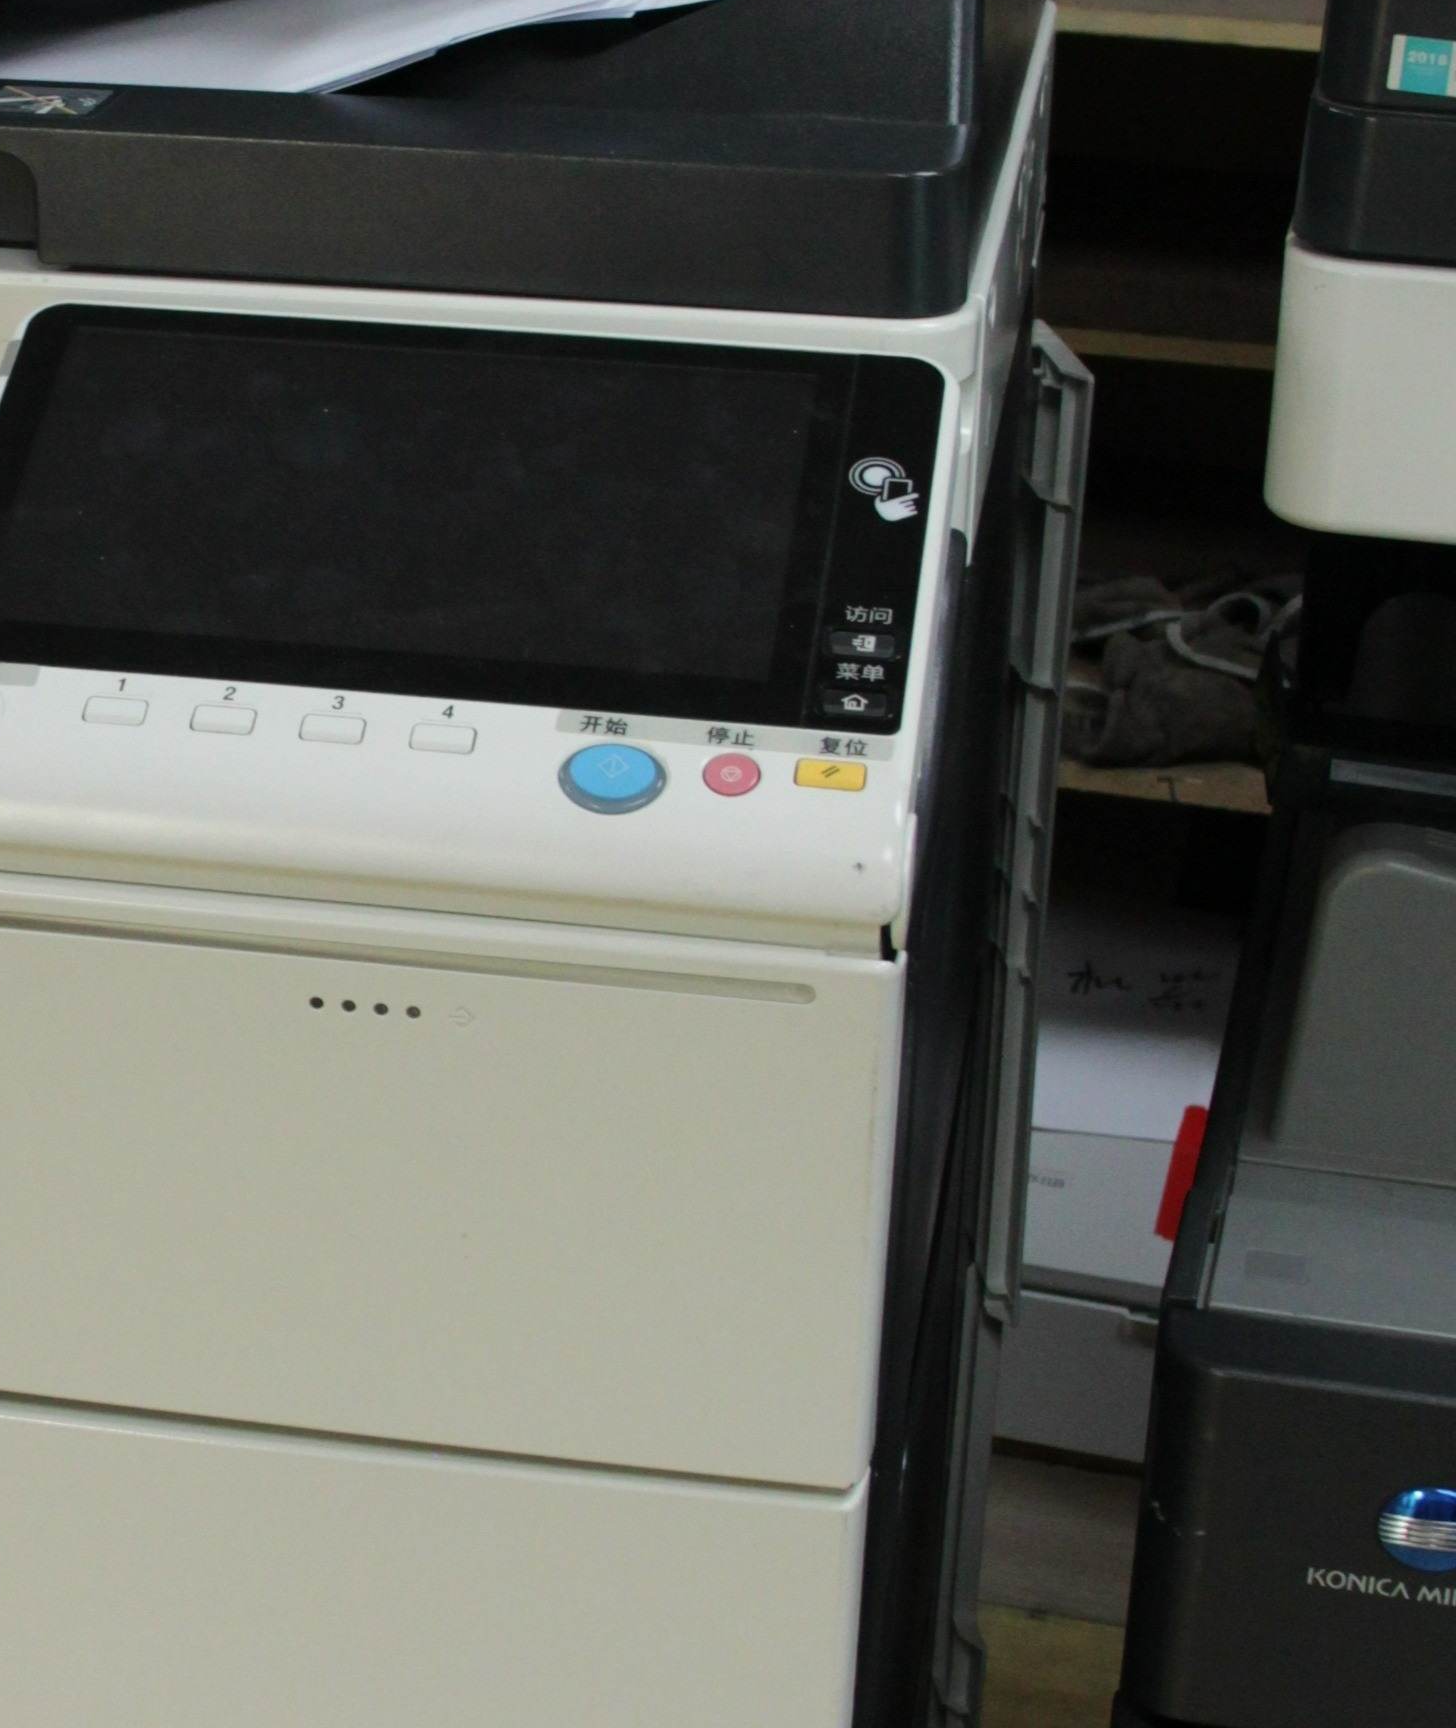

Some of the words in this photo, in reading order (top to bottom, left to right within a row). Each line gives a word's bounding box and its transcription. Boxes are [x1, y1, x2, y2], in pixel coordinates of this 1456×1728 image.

[844, 605, 894, 625] 访问
[835, 662, 886, 682] 菜单
[117, 678, 127, 693] 1
[223, 686, 237, 702] 2
[332, 695, 345, 711] 3
[441, 704, 455, 721] 4
[579, 715, 629, 737] 开始
[706, 726, 756, 748] 停止
[819, 736, 869, 759] 复位
[1307, 1566, 1410, 1601] KONICA
